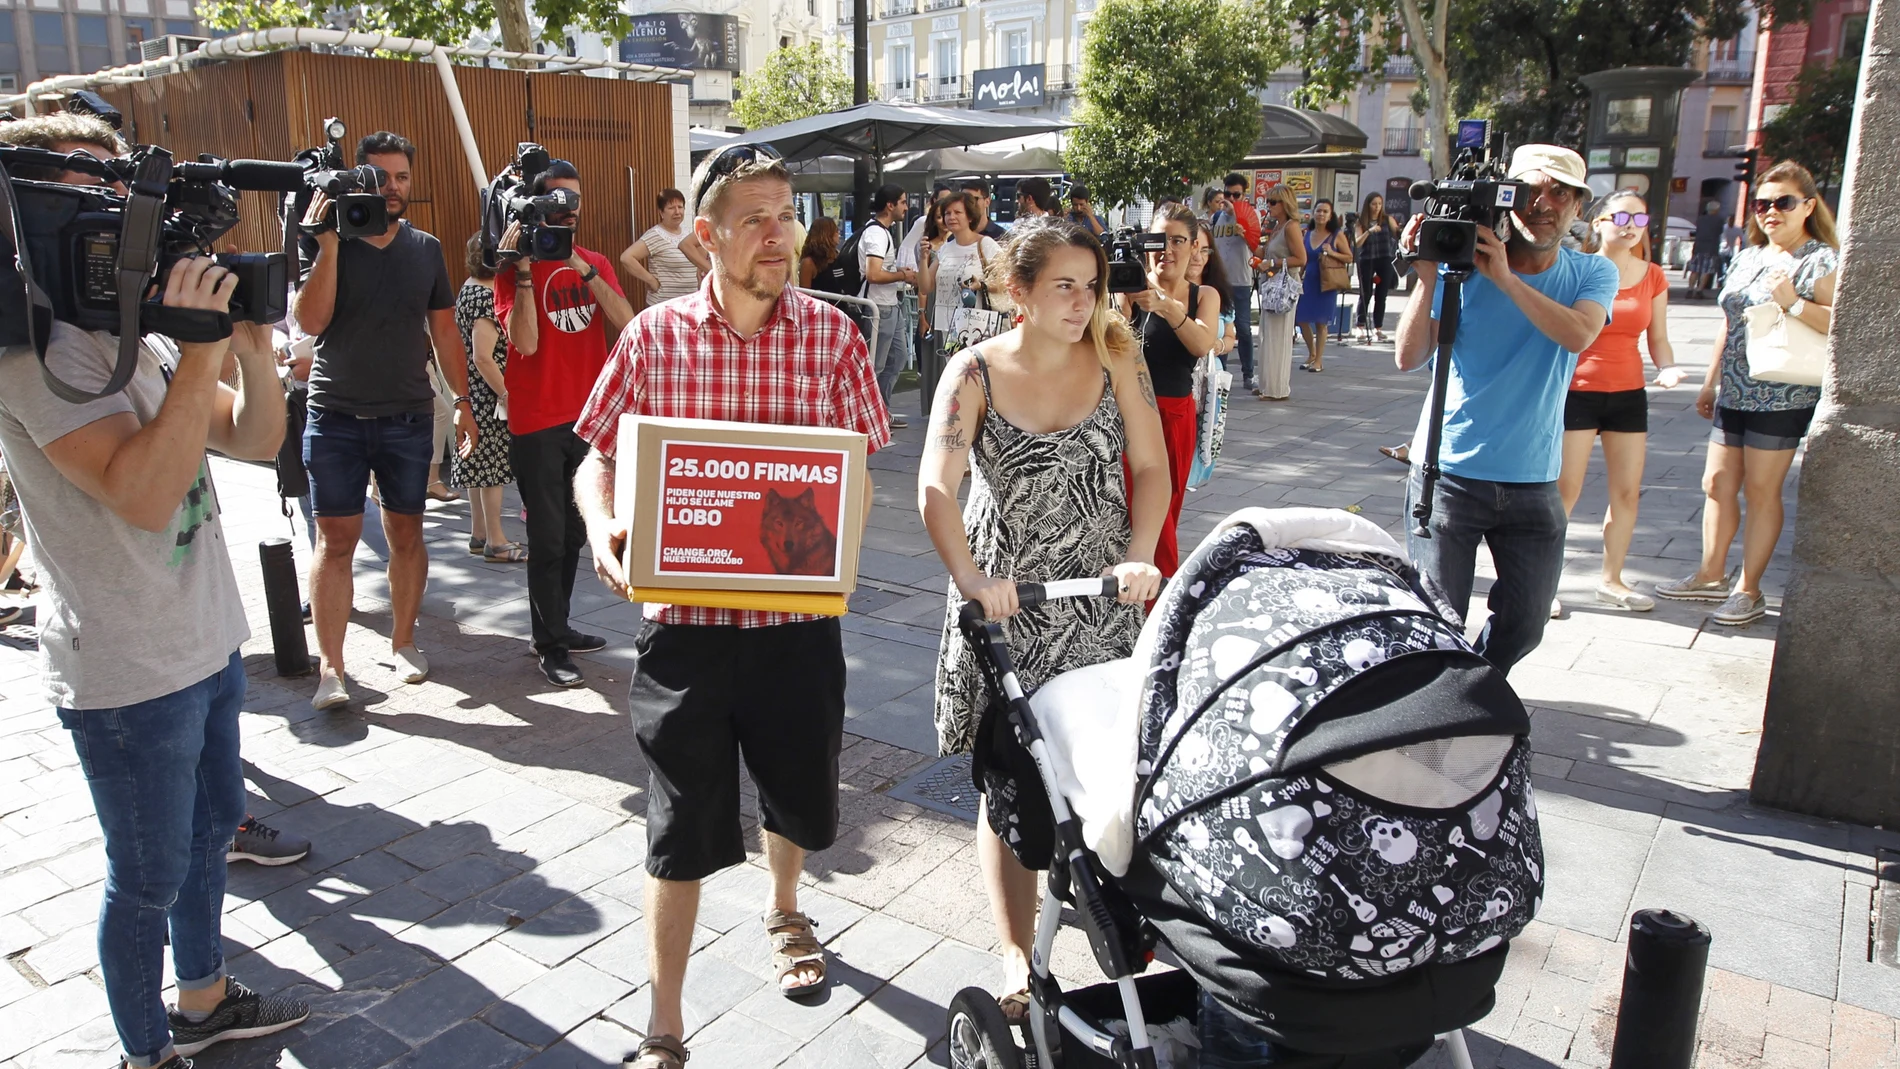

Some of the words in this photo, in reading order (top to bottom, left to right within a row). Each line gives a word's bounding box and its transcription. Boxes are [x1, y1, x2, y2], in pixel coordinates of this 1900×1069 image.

[668, 457, 750, 480] 25.000
[753, 461, 839, 484] FIRMAS
[666, 487, 695, 497] PIDEN
[696, 488, 717, 499] QUE
[717, 490, 761, 500] NUESTRO
[666, 496, 688, 506] HIJO
[689, 498, 703, 506] SE
[703, 498, 734, 508] LLAME
[667, 507, 722, 526] LOBO
[663, 547, 733, 559] CHANGE.ORG/
[662, 556, 743, 565] NUESTROHIJOLOBO
[1407, 899, 1438, 926] Baby
